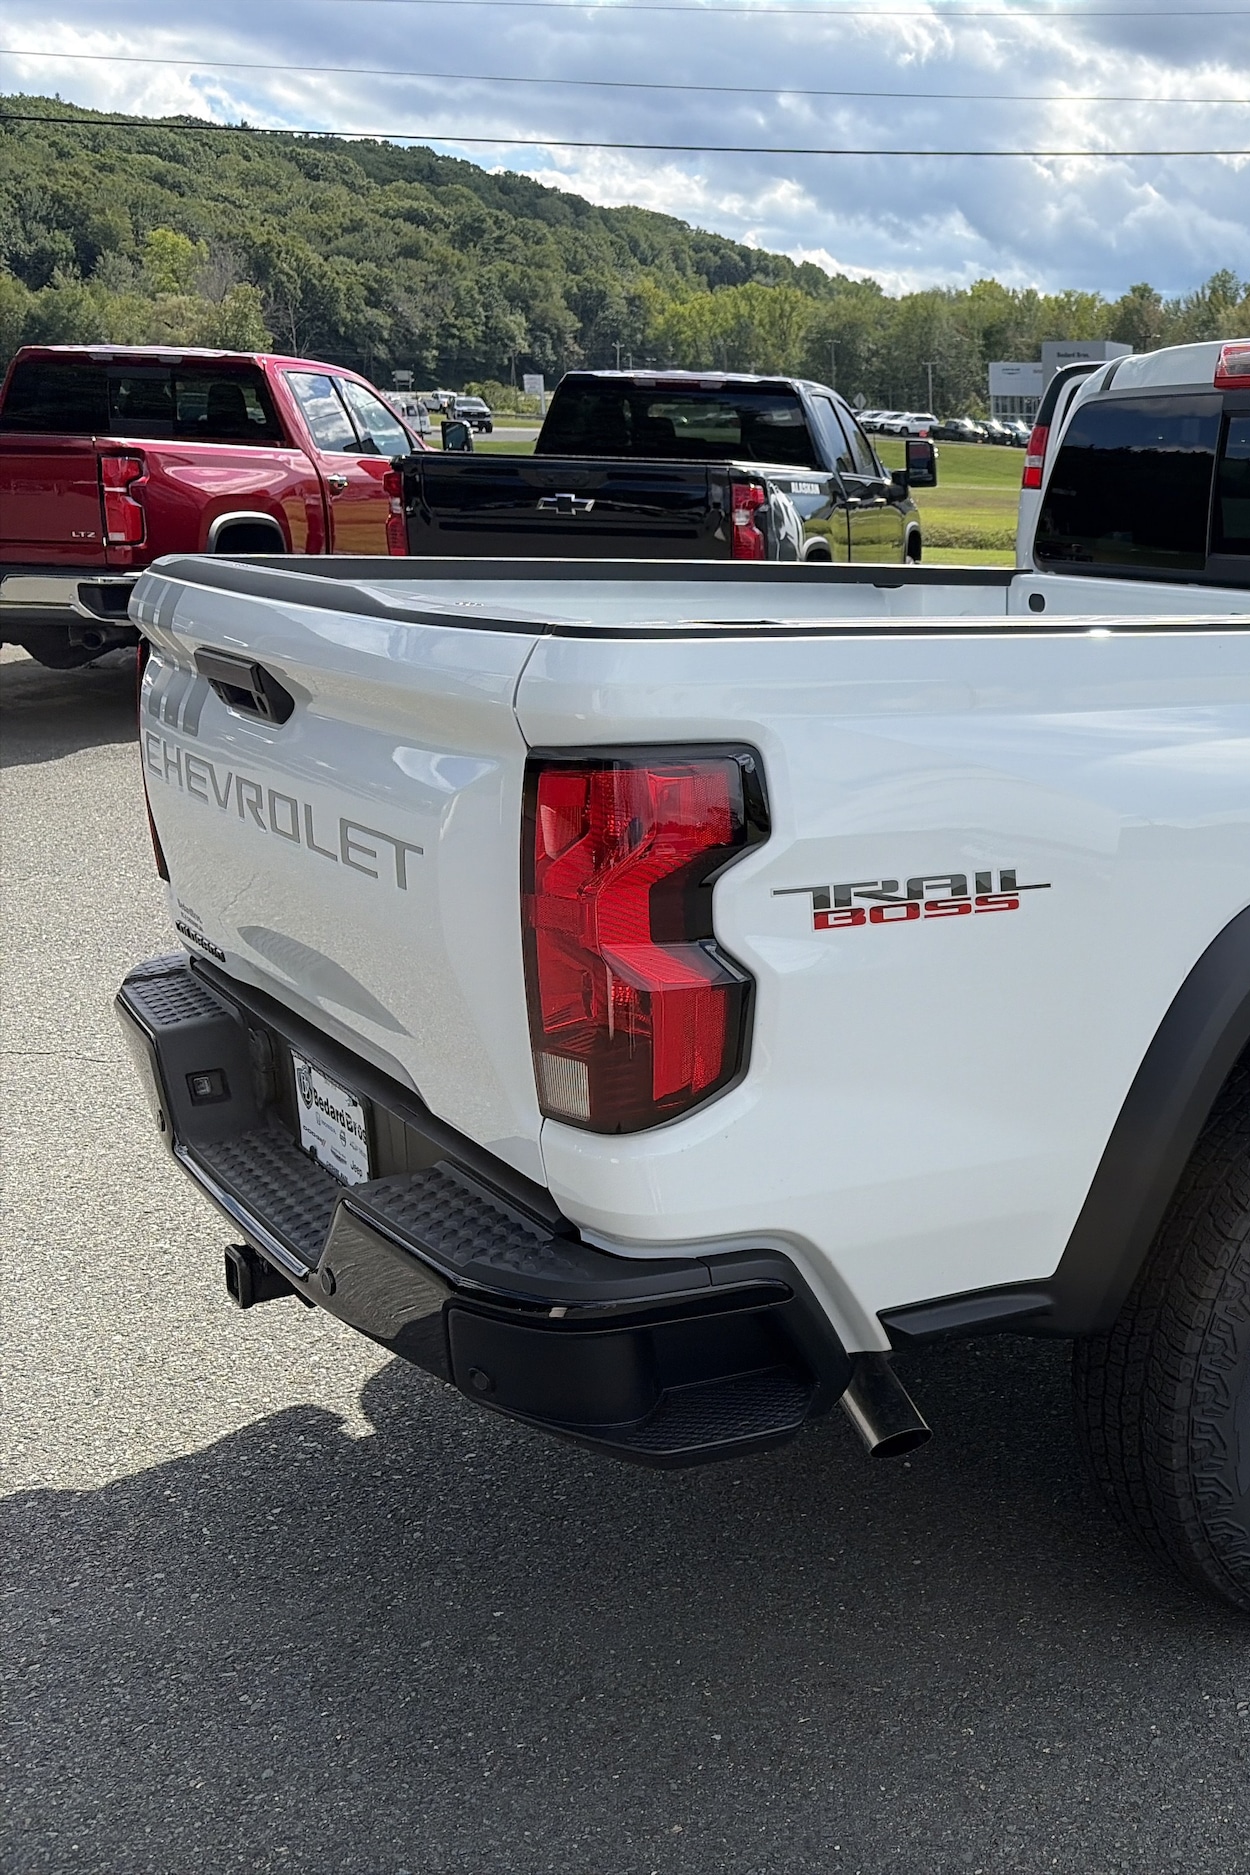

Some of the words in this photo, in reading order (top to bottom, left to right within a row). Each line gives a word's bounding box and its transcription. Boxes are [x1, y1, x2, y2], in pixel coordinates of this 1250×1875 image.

[145, 730, 424, 891] CHEVROLET
[772, 868, 1052, 910] TRAIL
[812, 892, 1020, 931] BOSS
[312, 1087, 346, 1128] Bedard
